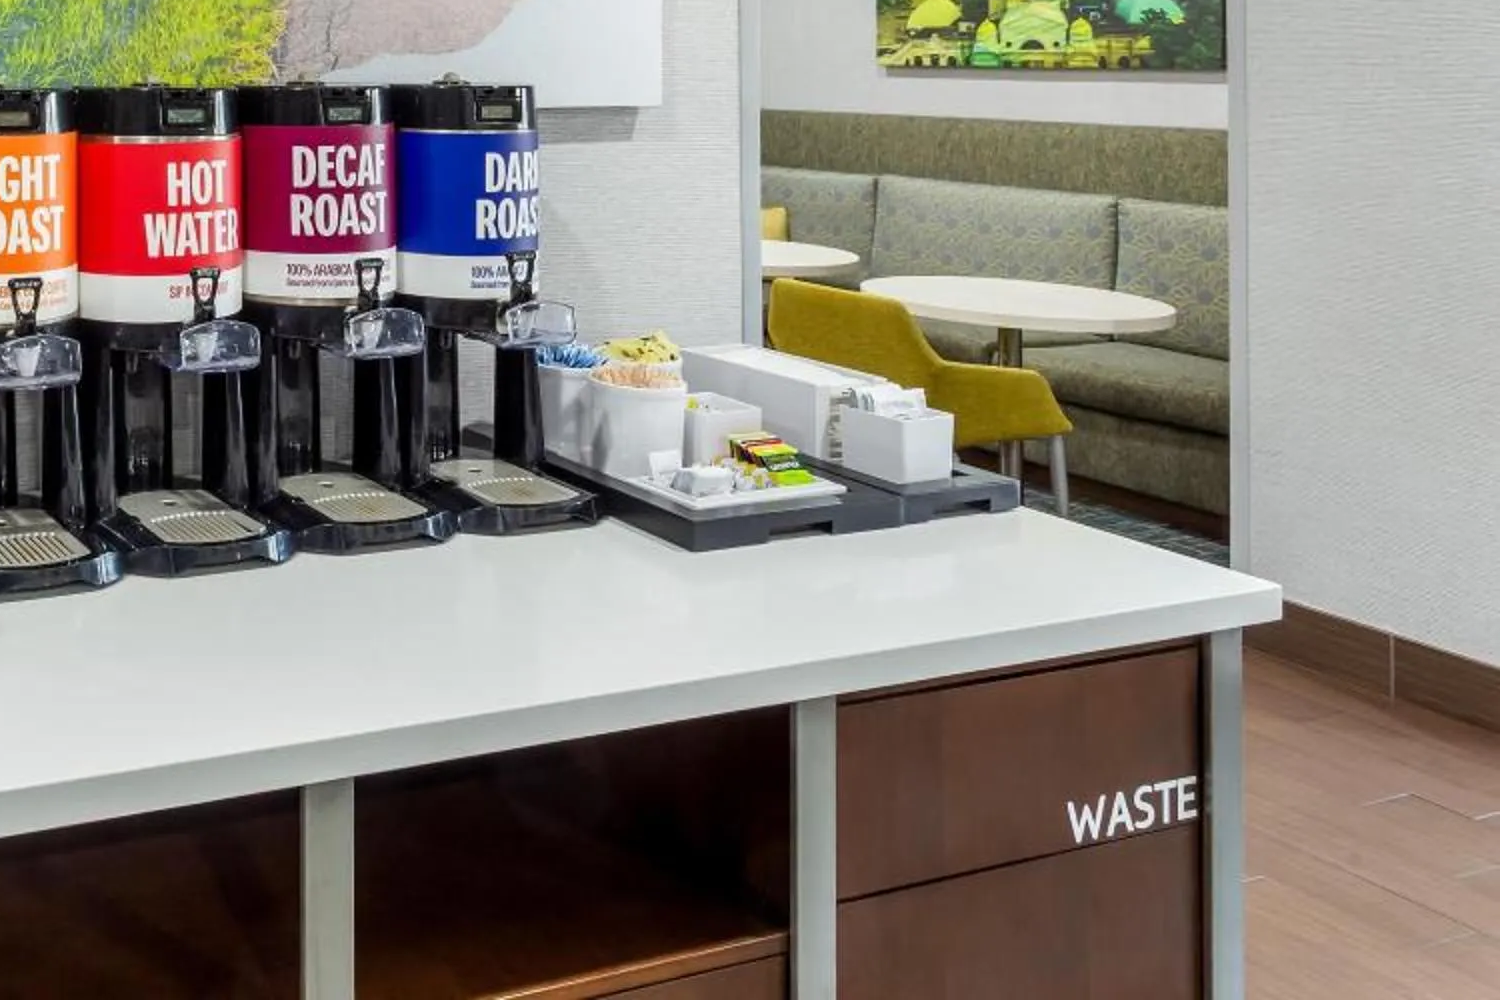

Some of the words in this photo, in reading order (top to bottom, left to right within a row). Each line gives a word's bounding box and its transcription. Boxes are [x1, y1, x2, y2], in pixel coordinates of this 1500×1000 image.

[167, 159, 227, 207] HOT
[291, 143, 386, 189] DECAF
[142, 207, 239, 258] WATER
[289, 191, 388, 237] ROAST
[475, 197, 540, 240] ROAS
[286, 263, 312, 277] 100%
[1067, 775, 1198, 844] WASTE
